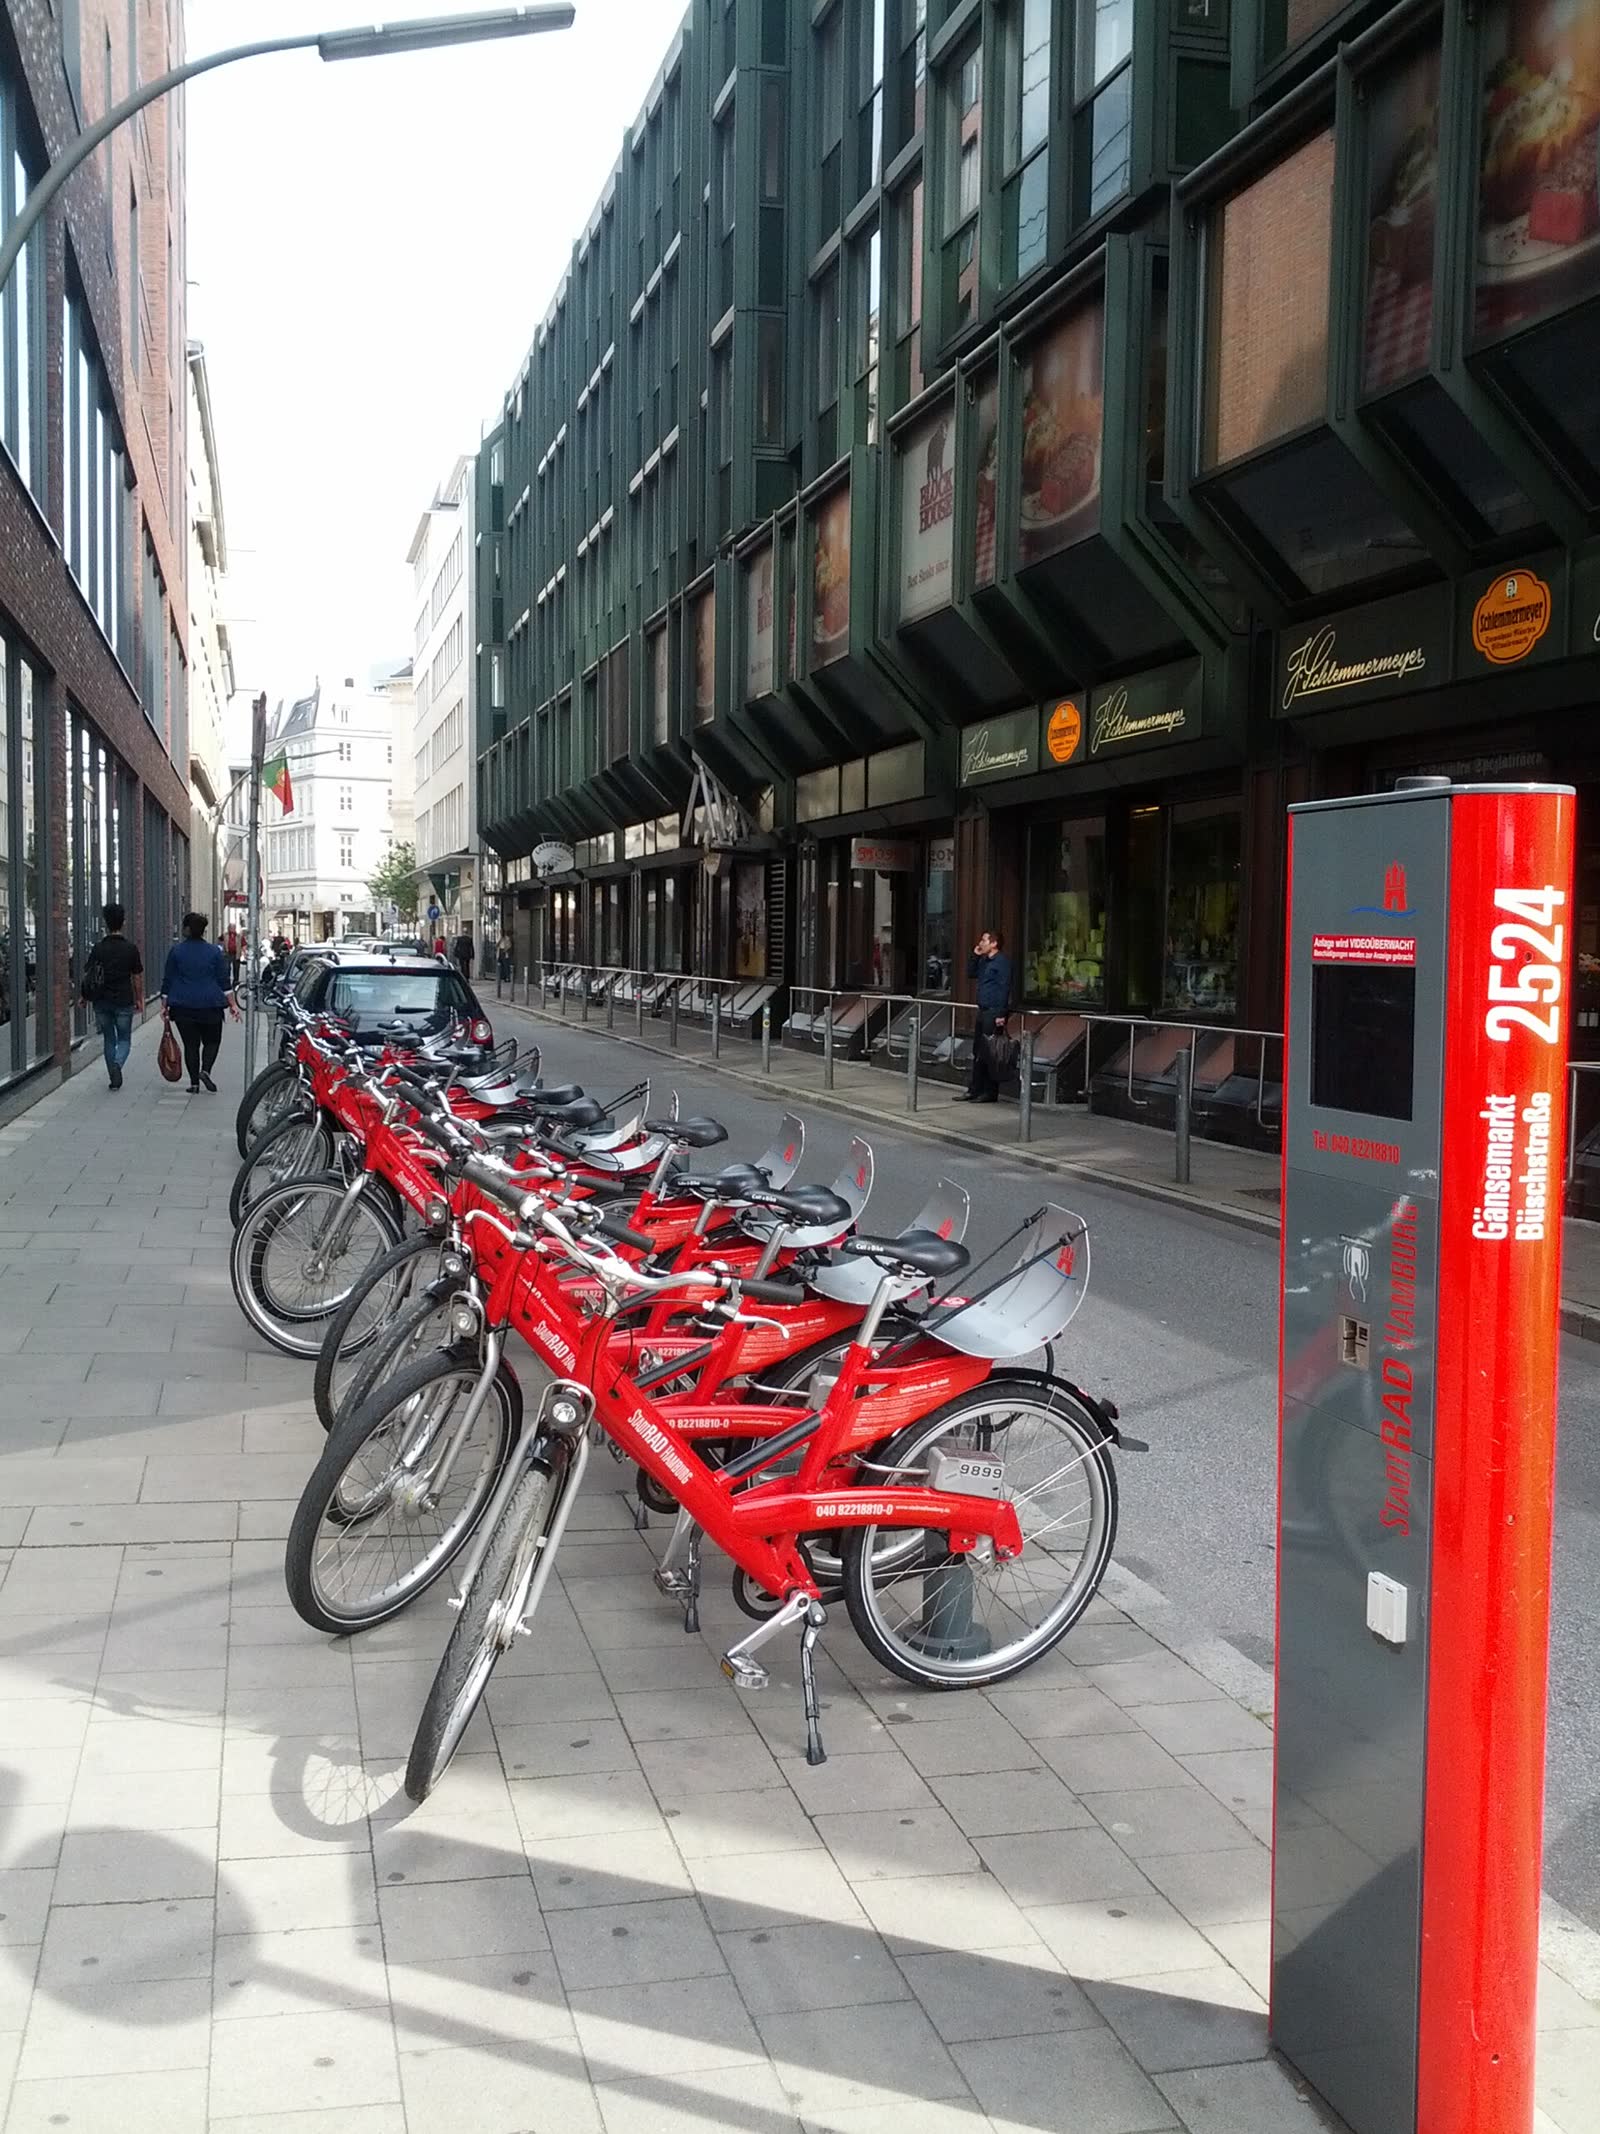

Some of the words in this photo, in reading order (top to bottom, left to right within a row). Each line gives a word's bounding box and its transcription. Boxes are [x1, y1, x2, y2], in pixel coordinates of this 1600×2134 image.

[1480, 602, 1543, 633] Schlemmermeyer
[1314, 937, 1334, 949] Anlage
[1335, 938, 1349, 948] wird
[1349, 937, 1415, 951] VIDEOÜBERWACHT
[1485, 885, 1565, 1044] 2524
[1312, 1129, 1329, 1151] Tel.
[1331, 1133, 1349, 1155] 040
[1351, 1138, 1400, 1165] 82218810
[1472, 1094, 1516, 1241] Gänsemarkt
[1515, 1091, 1552, 1241] Büschstraße
[677, 1418, 730, 1429] 82218810-0
[960, 1463, 1002, 1479] 9899
[816, 1505, 836, 1517] 040
[837, 1503, 894, 1516] 82218810-0
